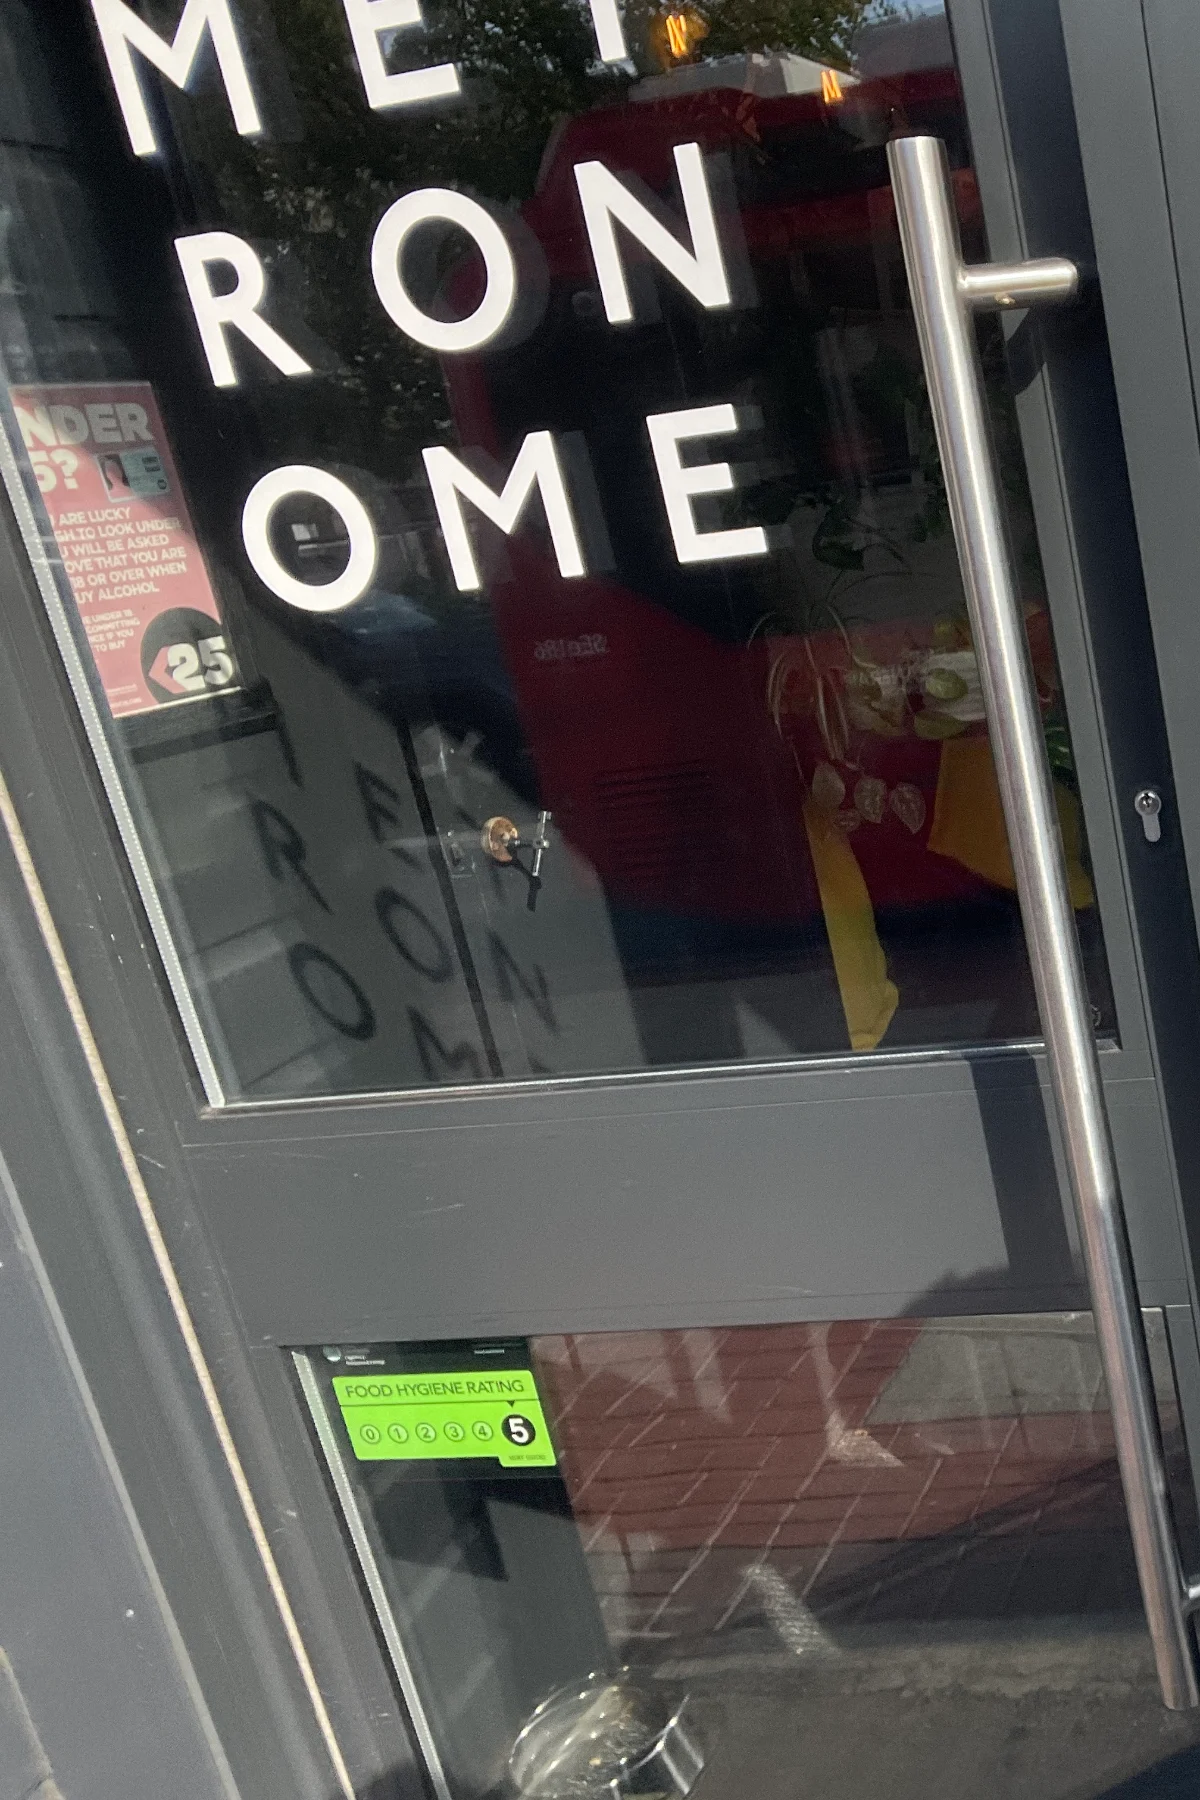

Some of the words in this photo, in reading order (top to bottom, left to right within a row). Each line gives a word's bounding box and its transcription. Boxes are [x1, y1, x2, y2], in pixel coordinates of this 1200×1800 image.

[174, 142, 732, 388] RON
[59, 510, 87, 526] ARE
[88, 506, 131, 522] LUCKY
[241, 403, 769, 612] OME
[76, 527, 96, 540] TO
[97, 522, 135, 538] LOOK
[135, 516, 182, 533] UNDER
[71, 541, 105, 557] WILL
[106, 539, 125, 552] BE
[127, 533, 170, 550] ASKED
[97, 554, 128, 569] THAT
[130, 550, 158, 565] YOU
[161, 546, 187, 560] ARE
[87, 572, 108, 586] OR
[109, 567, 145, 582] OVER
[146, 561, 188, 578] WHEN
[98, 581, 160, 601] ALCOHOL
[344, 1383, 393, 1399] FOOD
[395, 1381, 466, 1397] HYGIENE
[466, 1378, 525, 1395] RATING
[508, 1417, 530, 1444] 5
